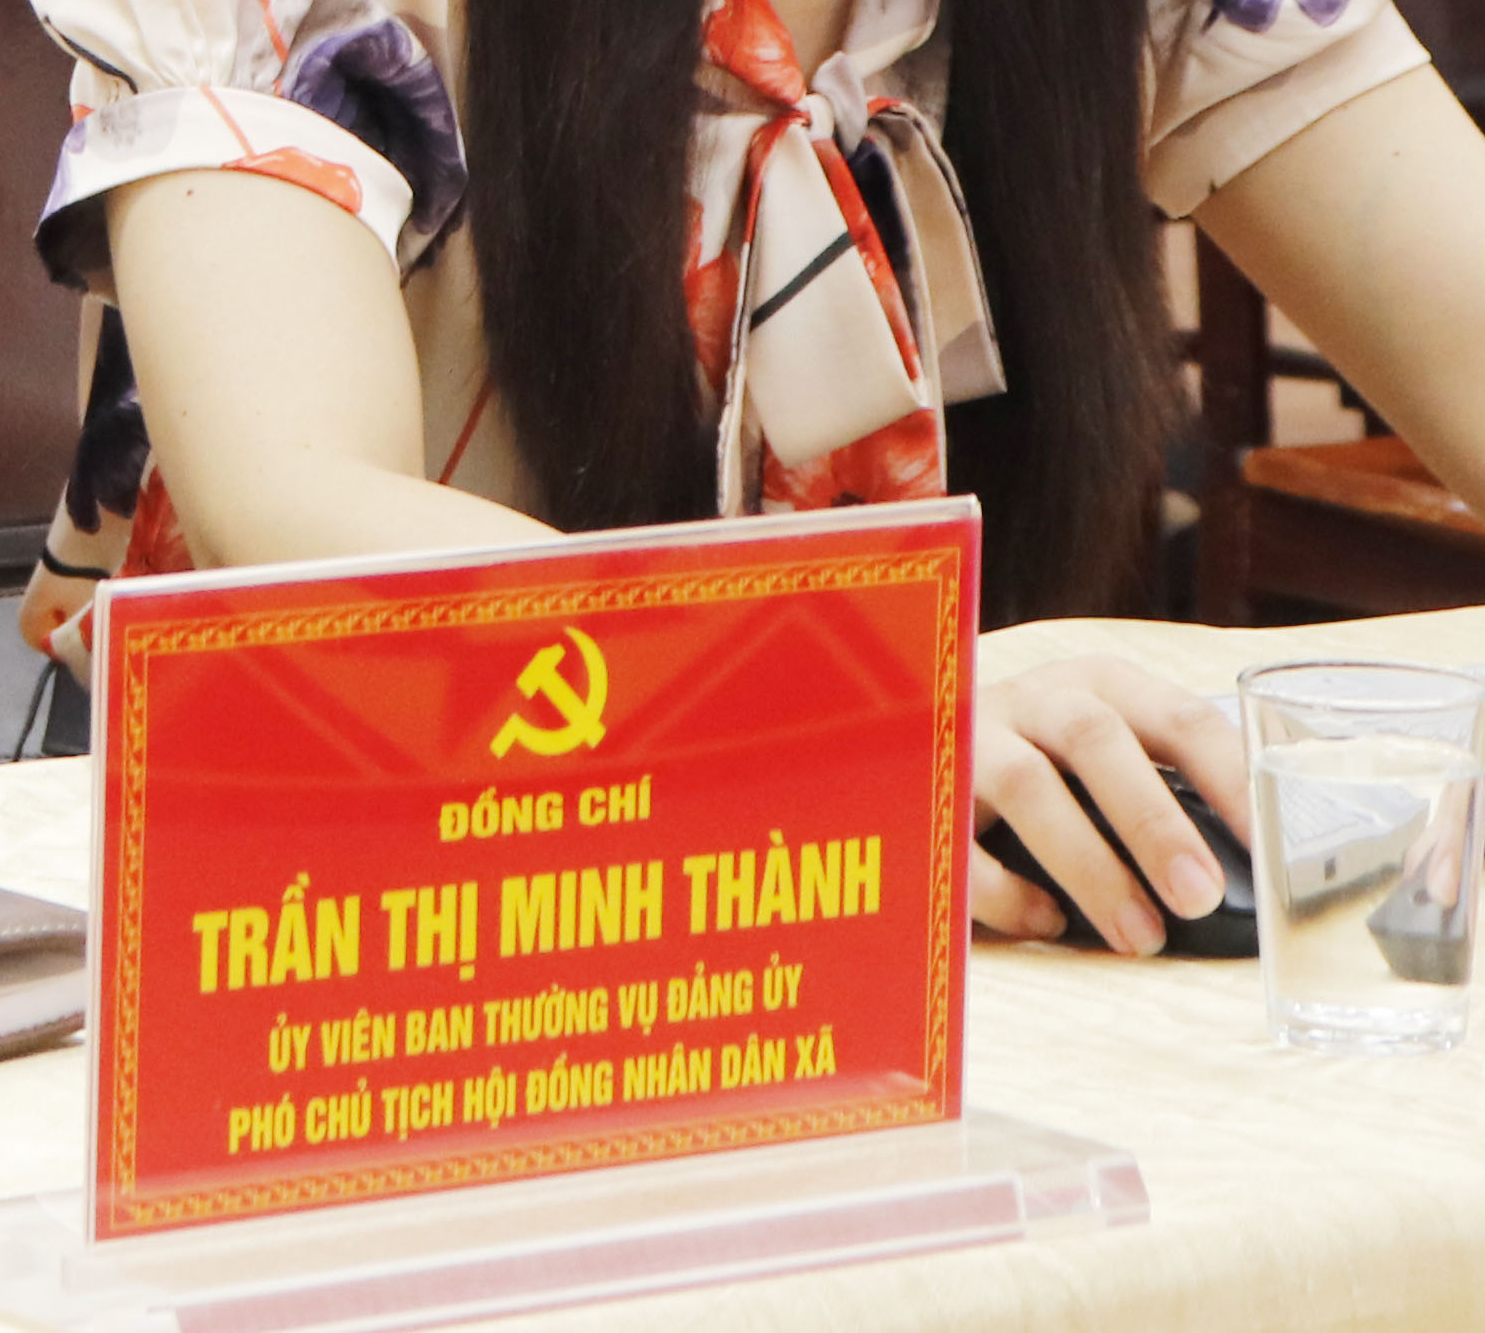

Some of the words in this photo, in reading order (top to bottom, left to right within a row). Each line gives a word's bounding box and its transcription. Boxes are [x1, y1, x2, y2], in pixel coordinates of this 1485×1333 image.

[193, 873, 360, 993] TRẦN
[381, 882, 478, 980] THỊ
[500, 861, 663, 957] MINH
[683, 831, 881, 933] THÀNH
[269, 1013, 311, 1073] ỦY
[321, 1009, 395, 1066] VIÊN
[406, 1005, 473, 1055] BAN
[483, 984, 608, 1045] THƯỜNG
[618, 982, 658, 1035] VỤ
[667, 962, 753, 1022] ĐẢNG
[763, 954, 802, 1010] ỦY
[229, 1093, 295, 1153] PHÓ
[305, 1078, 371, 1144] CHỦ
[382, 1082, 454, 1141] TỊCH
[463, 1067, 516, 1129] HỘI
[623, 1043, 711, 1101] NHÂN
[721, 1034, 785, 1089] DÂN
[795, 1026, 836, 1079] XÃ
